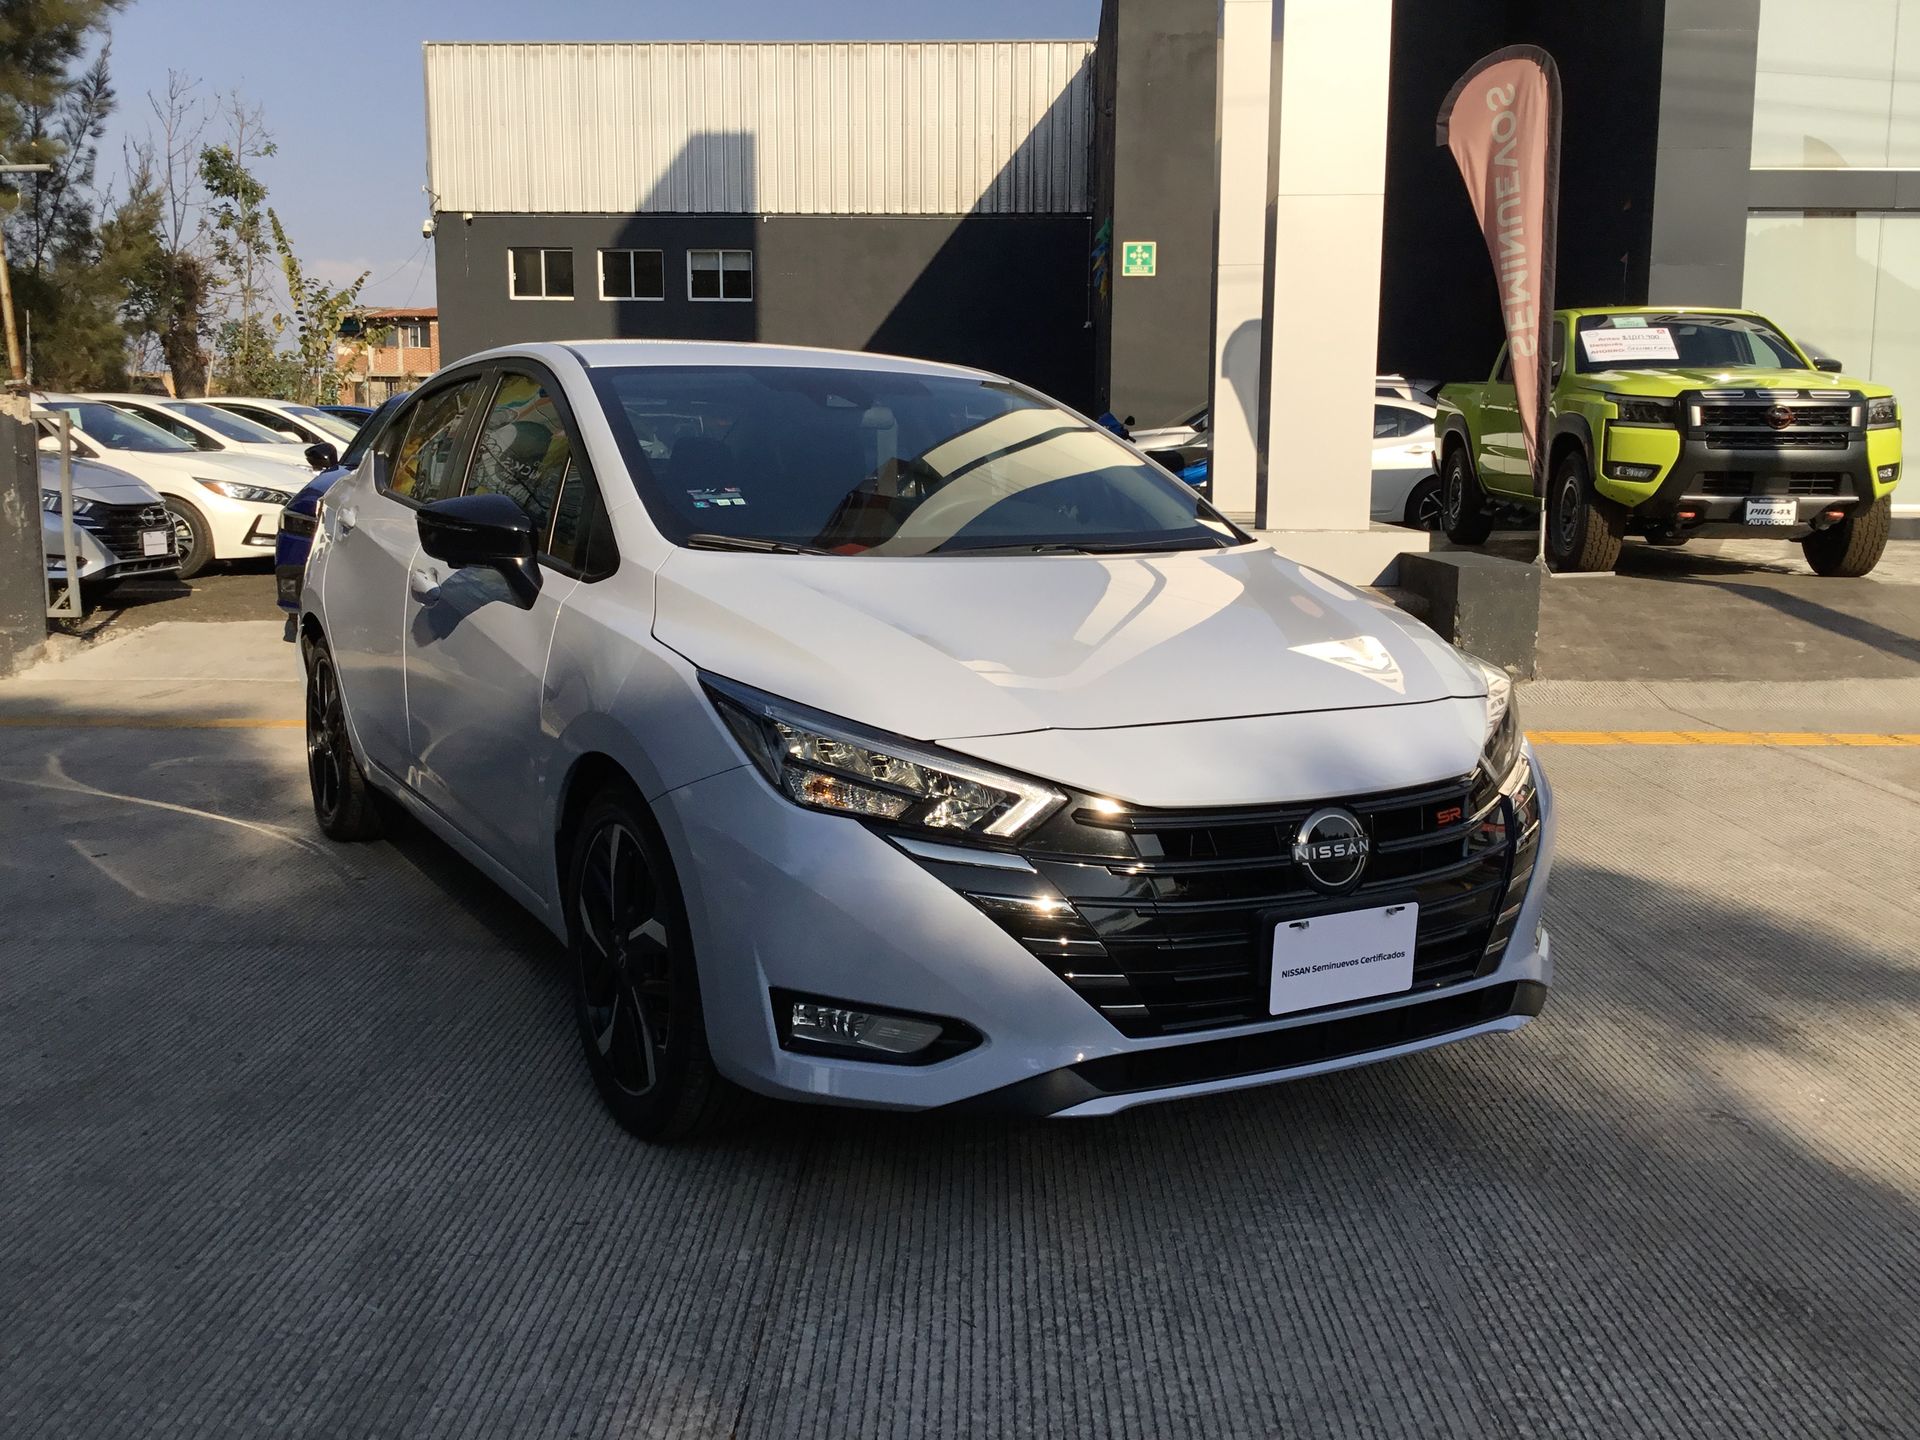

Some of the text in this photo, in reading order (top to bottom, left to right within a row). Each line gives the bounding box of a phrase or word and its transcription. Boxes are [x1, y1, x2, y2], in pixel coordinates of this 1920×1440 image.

[1437, 807, 1462, 824] SR
[1295, 839, 1369, 861] NISSAN
[1281, 950, 1406, 978] NISSAN Seminuevos Certificados
